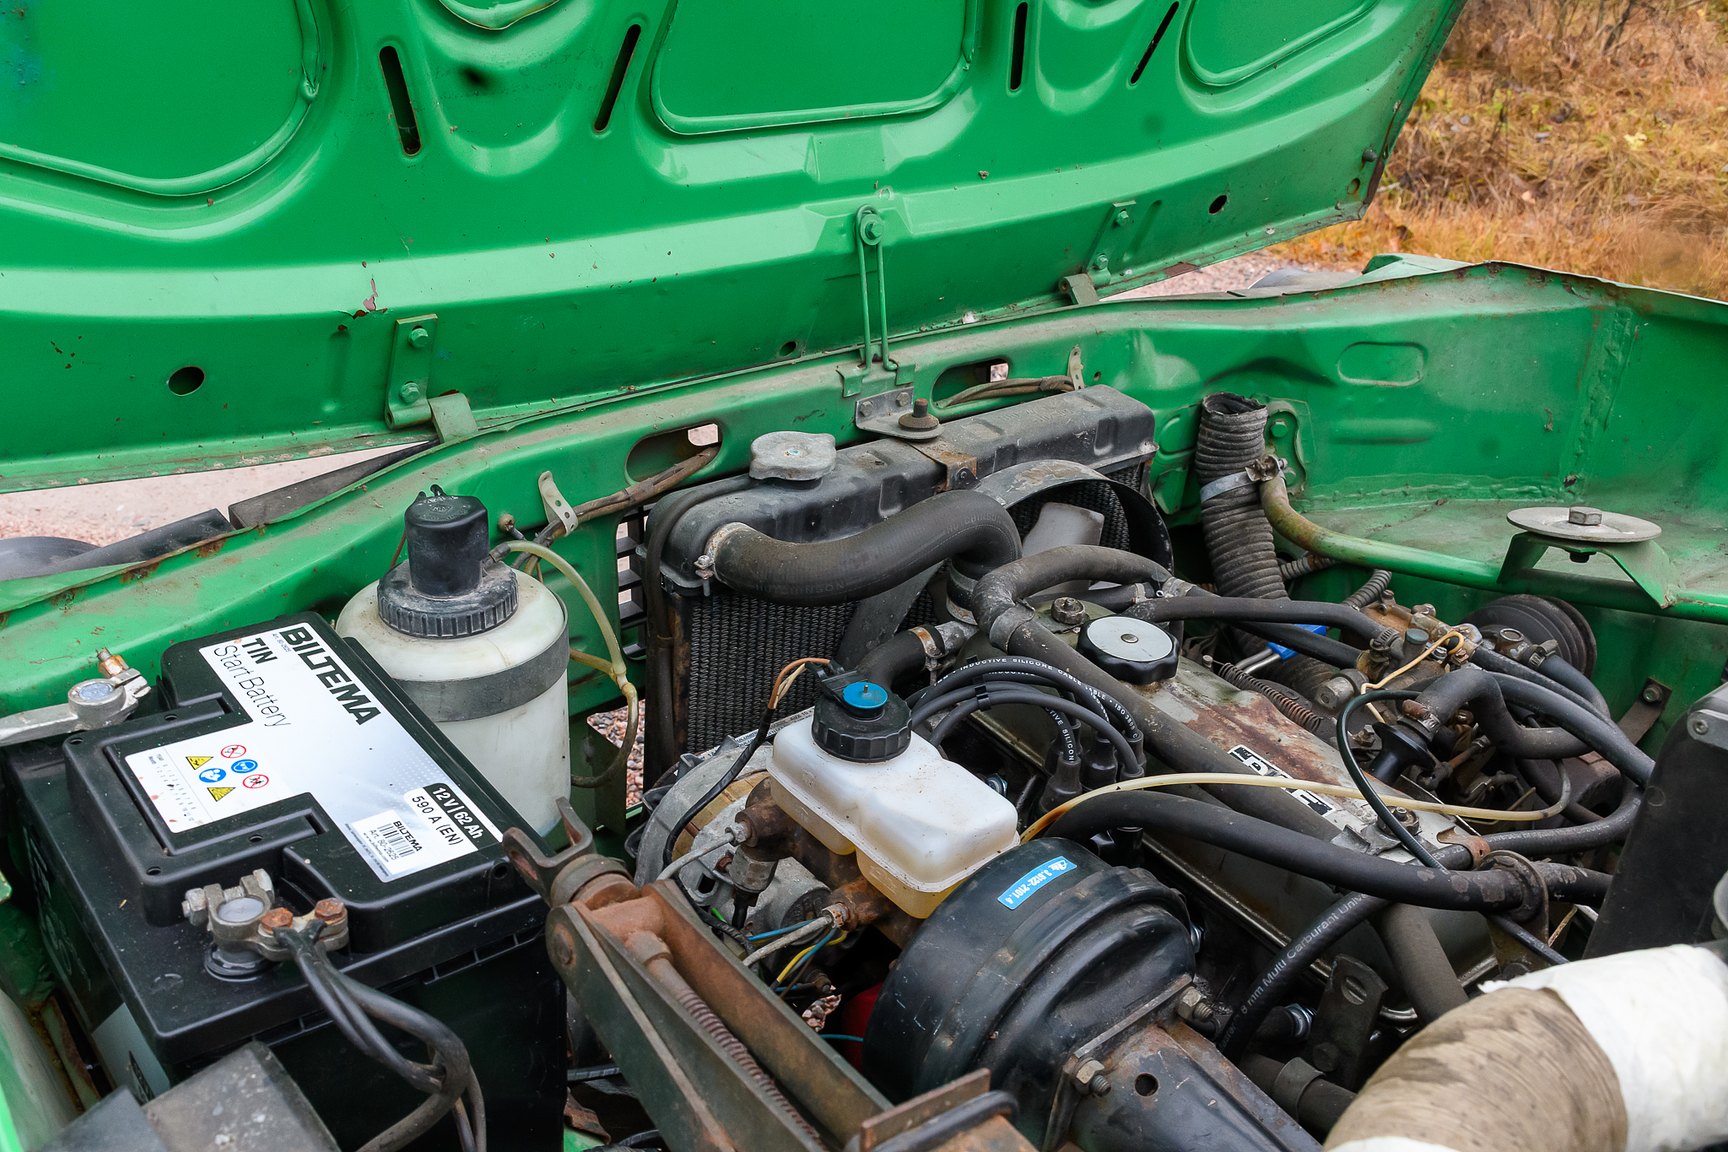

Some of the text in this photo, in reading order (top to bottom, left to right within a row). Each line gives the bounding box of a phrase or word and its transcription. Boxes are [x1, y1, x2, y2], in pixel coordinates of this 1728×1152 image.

[242, 637, 278, 664] TIN
[279, 627, 381, 725] BILTEMA
[214, 644, 254, 678] Start
[239, 676, 291, 727] Battery
[393, 820, 422, 852] BILTEMA
[411, 795, 464, 846] 590 A (EN)
[1240, 1004, 1248, 1015] 8
[1262, 958, 1288, 988] Multi
[1286, 911, 1340, 960] Carburant
